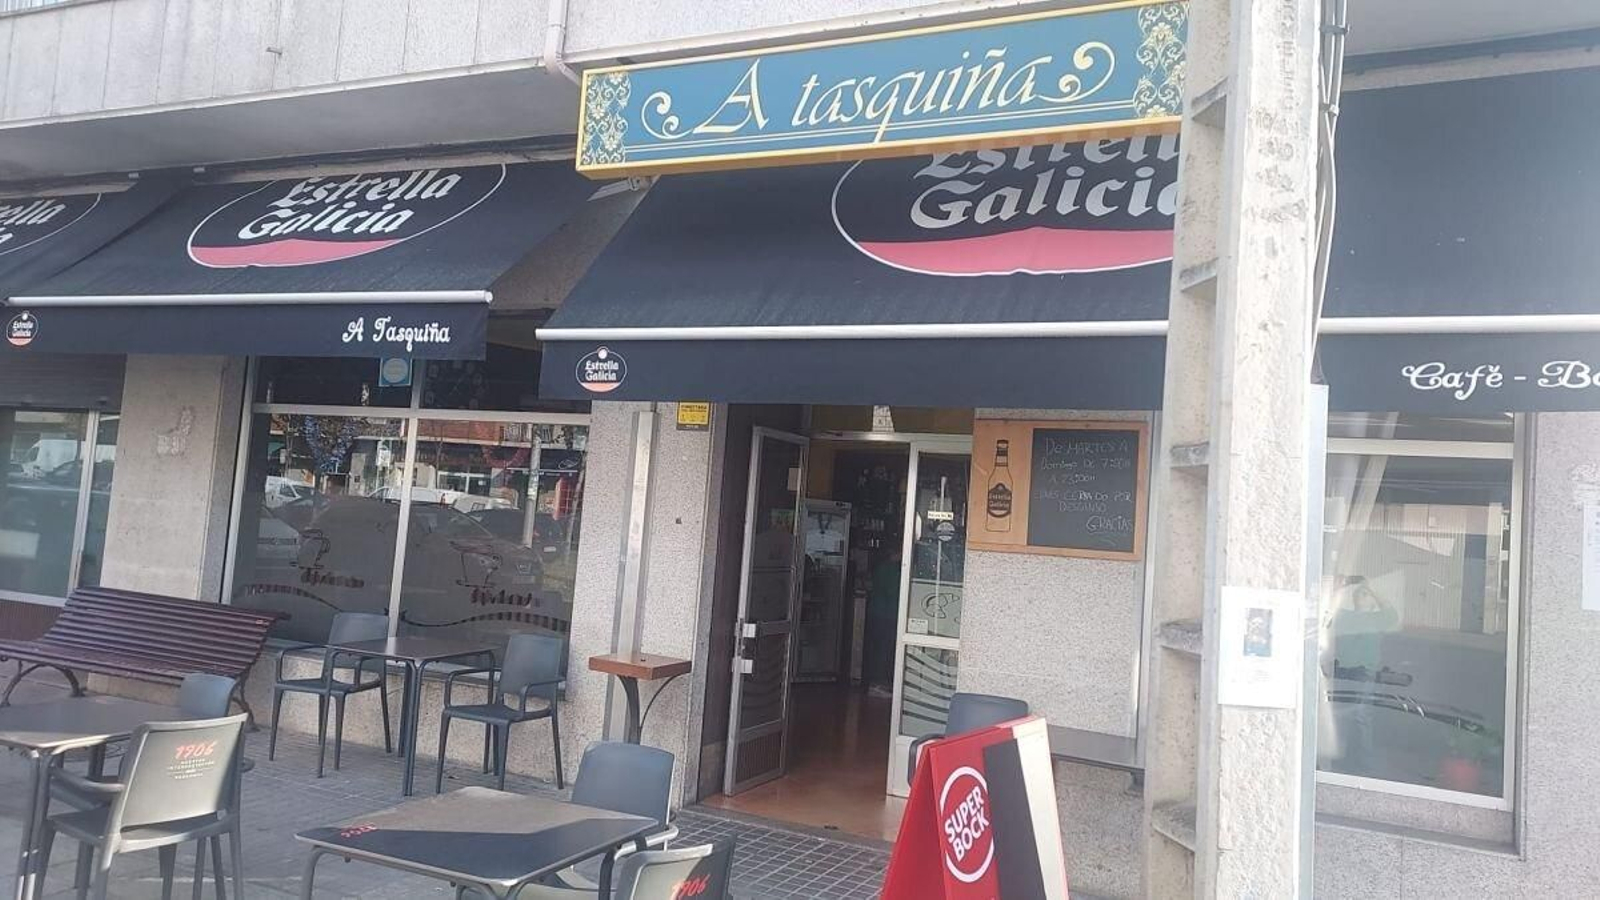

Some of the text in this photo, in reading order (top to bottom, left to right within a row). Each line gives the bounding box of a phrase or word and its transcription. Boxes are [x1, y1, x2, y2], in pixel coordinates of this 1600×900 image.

[690, 45, 1054, 144] A tasquiña
[913, 134, 1182, 180] Estrell
[266, 168, 463, 209] Estrella
[237, 200, 415, 240] Galicia
[342, 315, 451, 352] A Tasquiña
[584, 369, 617, 381] Galicia
[585, 360, 619, 370] Estrella
[944, 786, 984, 844] SUPER
[953, 806, 990, 862] BOCK
